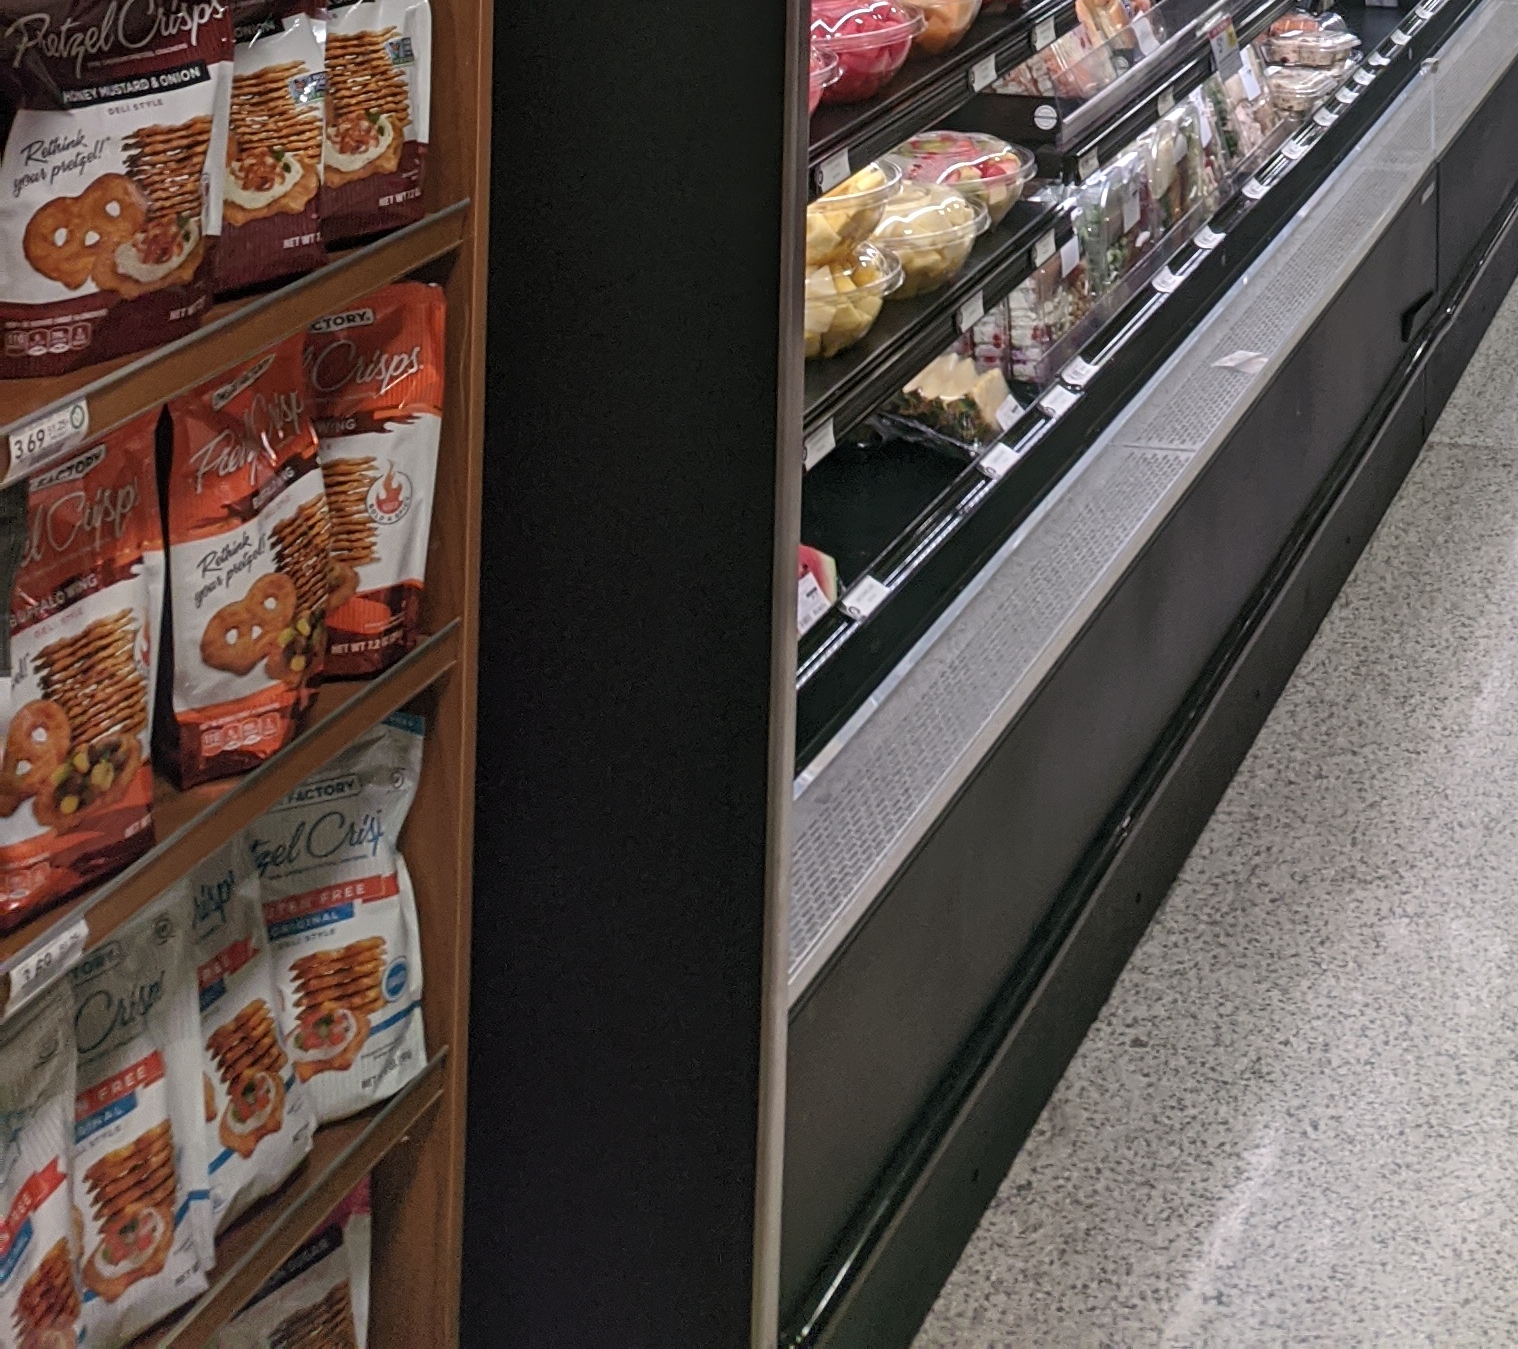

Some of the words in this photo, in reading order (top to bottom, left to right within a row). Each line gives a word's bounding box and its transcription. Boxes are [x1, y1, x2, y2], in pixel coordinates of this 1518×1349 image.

[4, 0, 117, 79] Pretzel
[63, 88, 98, 102] HONEY
[99, 79, 149, 99] MUSTARD
[160, 66, 201, 86] ONION
[20, 129, 88, 166] Rethink
[13, 166, 48, 198] your
[311, 339, 420, 395] Crisps
[320, 884, 367, 903] FREE
